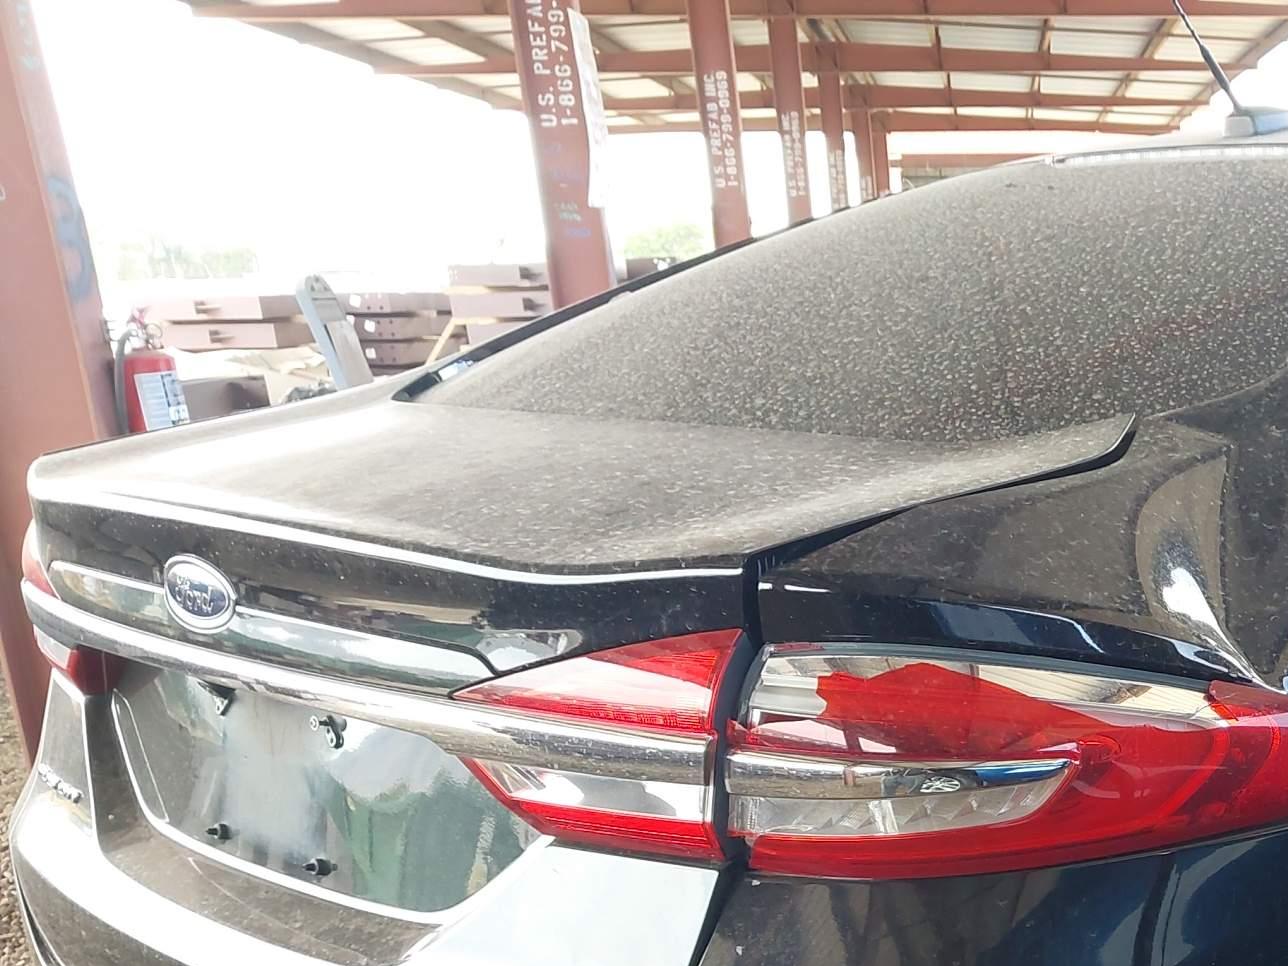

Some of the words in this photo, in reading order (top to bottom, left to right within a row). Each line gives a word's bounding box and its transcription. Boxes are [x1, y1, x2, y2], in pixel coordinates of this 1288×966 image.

[537, 86, 558, 128] U.S.
[706, 102, 723, 156] PREFAB
[175, 575, 214, 614] Ford
